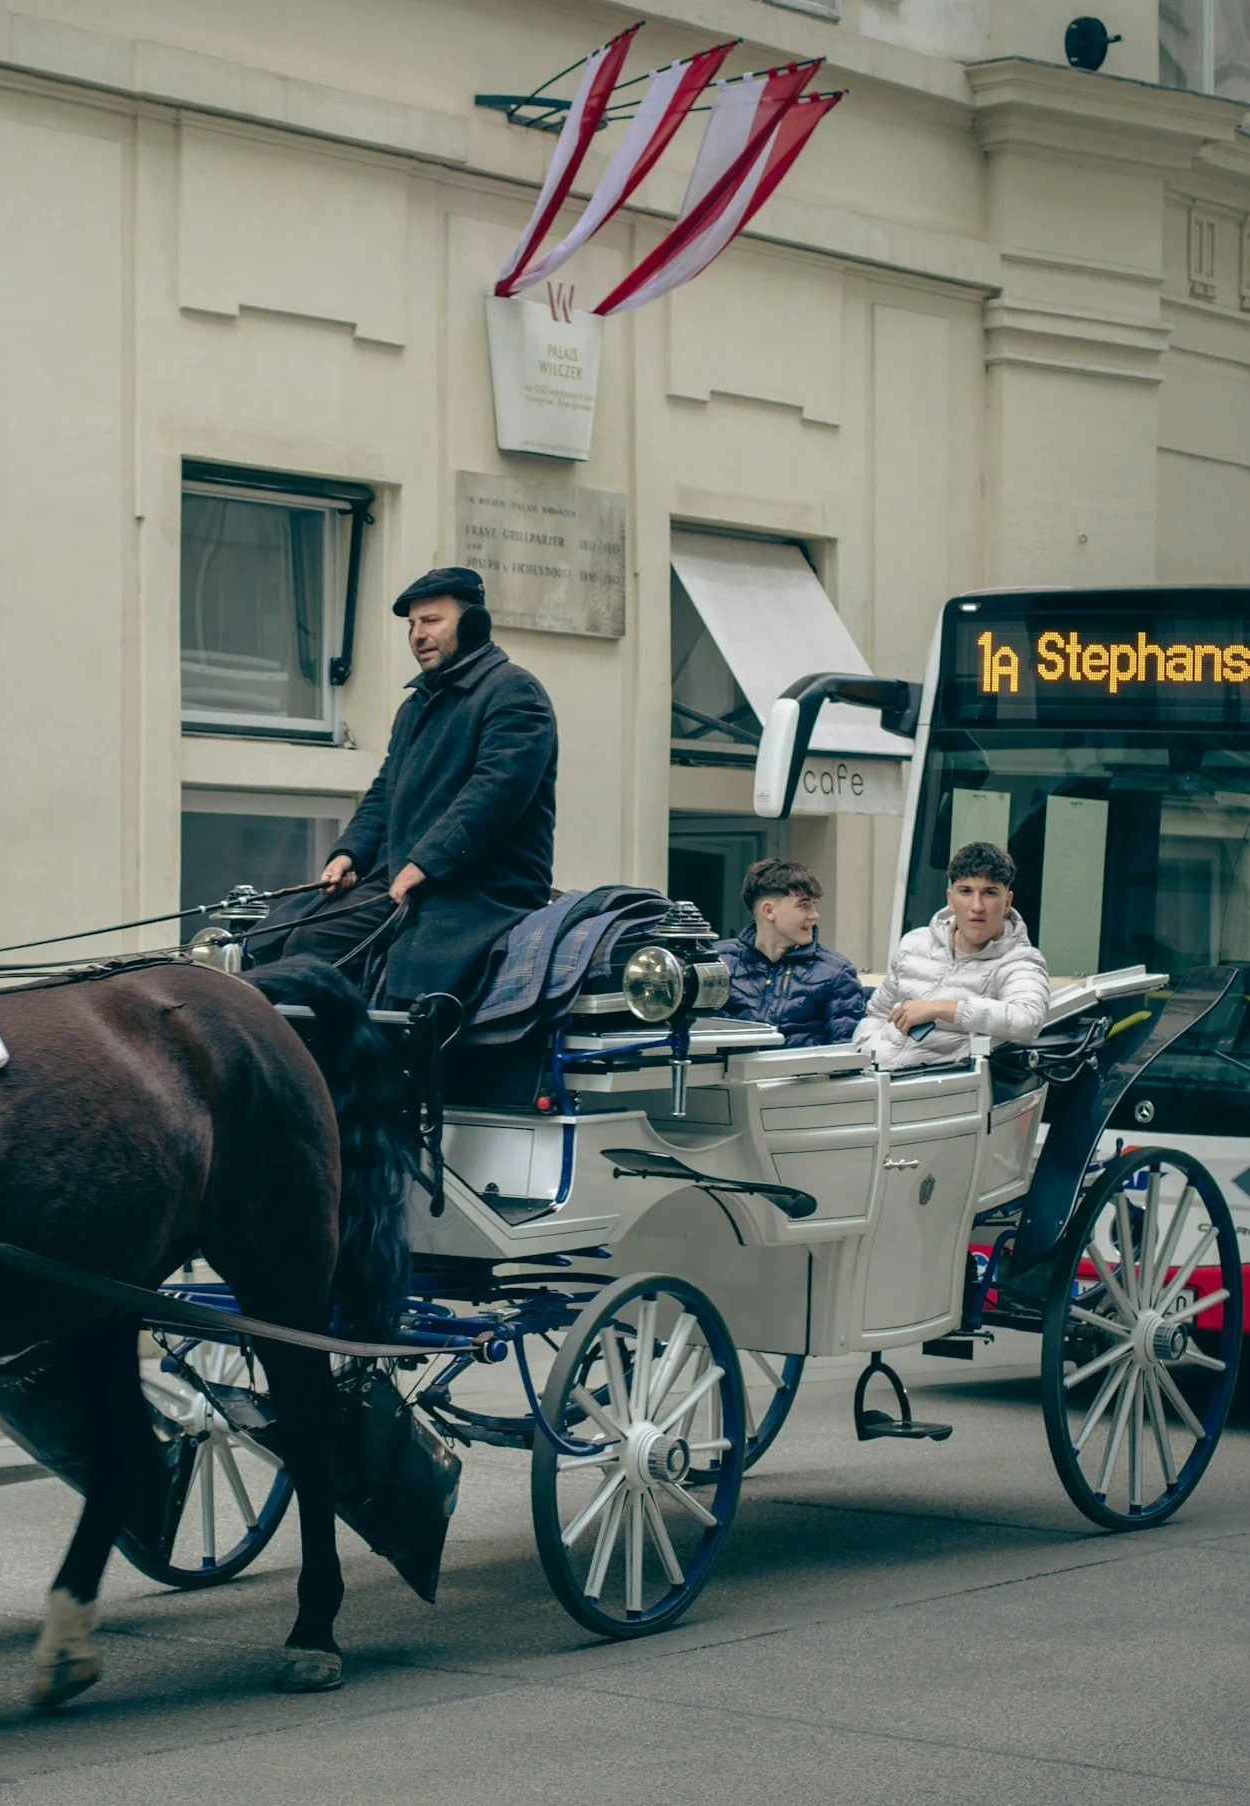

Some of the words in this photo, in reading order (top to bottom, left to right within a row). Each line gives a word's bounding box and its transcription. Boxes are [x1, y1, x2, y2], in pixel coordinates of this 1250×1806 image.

[546, 344, 579, 363] PALAIS
[537, 360, 584, 382] WILCZEK
[465, 524, 497, 539] FRANZ
[501, 528, 566, 549] GRILLPARZER
[466, 556, 501, 572] JOSEPH
[977, 631, 1020, 693] 1A
[1036, 631, 1250, 694] Stephans
[802, 763, 864, 797] cafe
